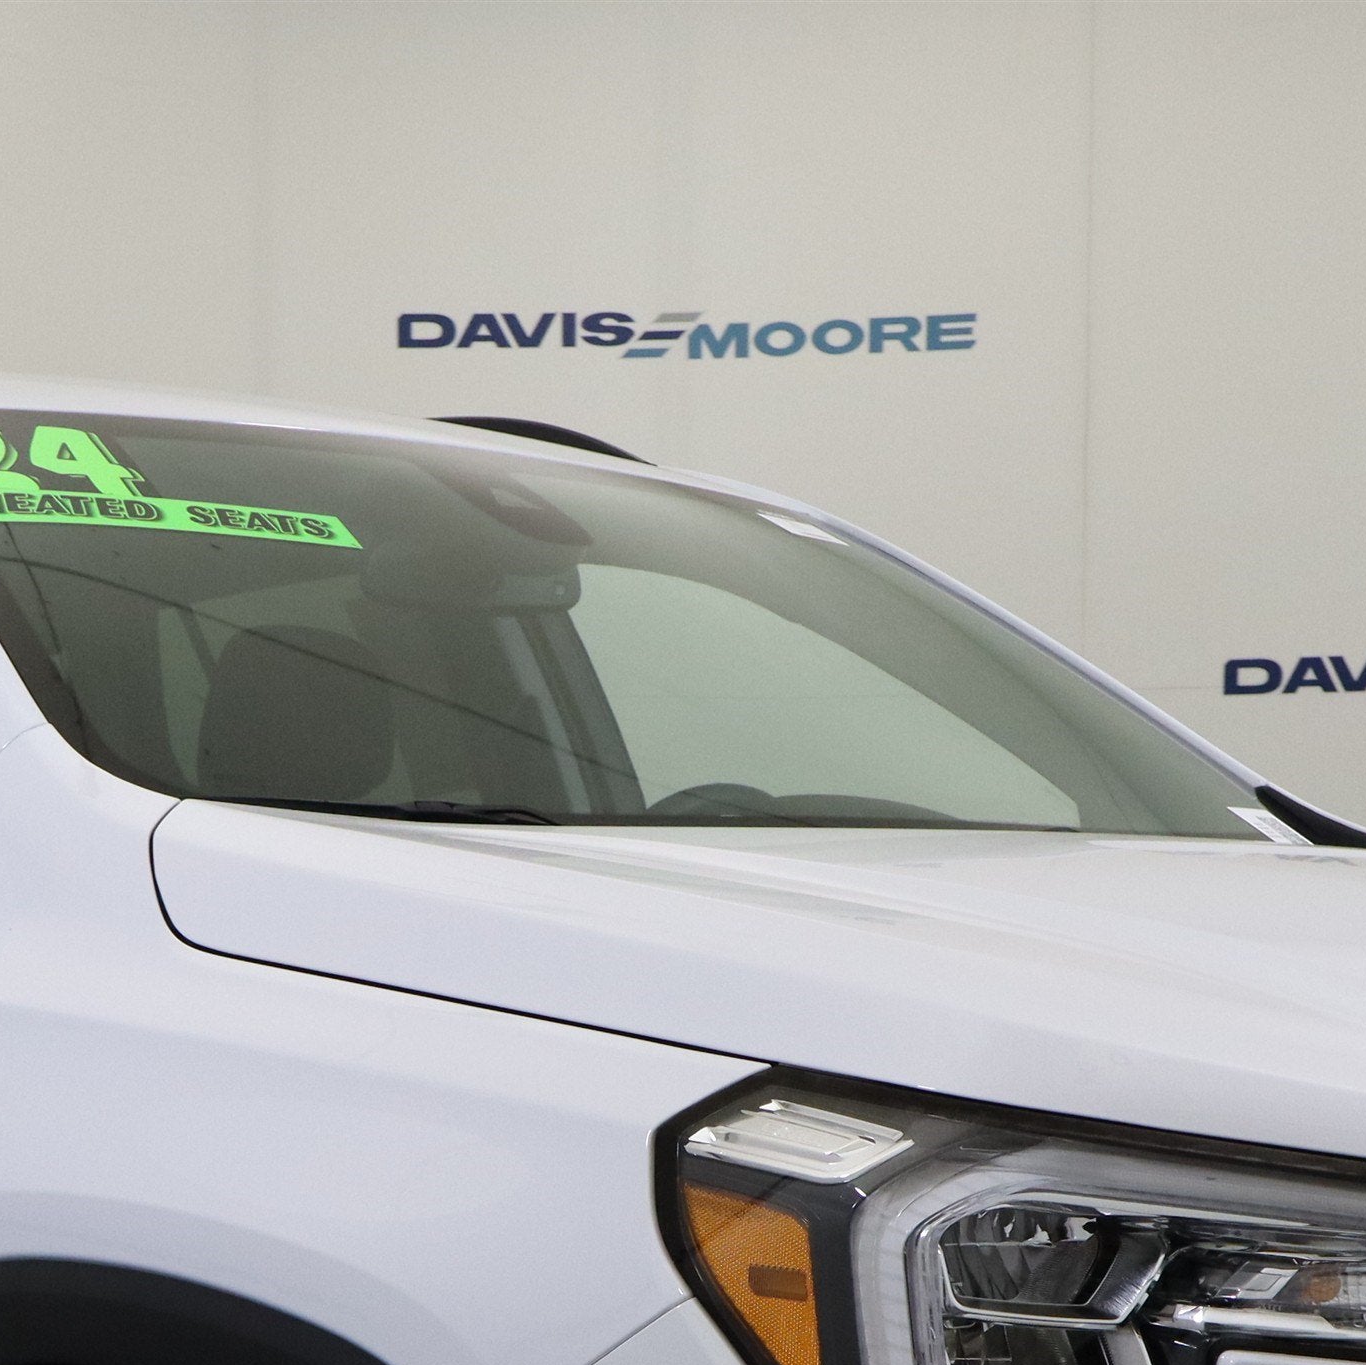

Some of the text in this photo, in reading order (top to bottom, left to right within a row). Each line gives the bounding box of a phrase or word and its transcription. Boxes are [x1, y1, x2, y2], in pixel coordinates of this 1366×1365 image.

[397, 311, 978, 359] DAVIS MOORE
[190, 504, 336, 541] SEATS
